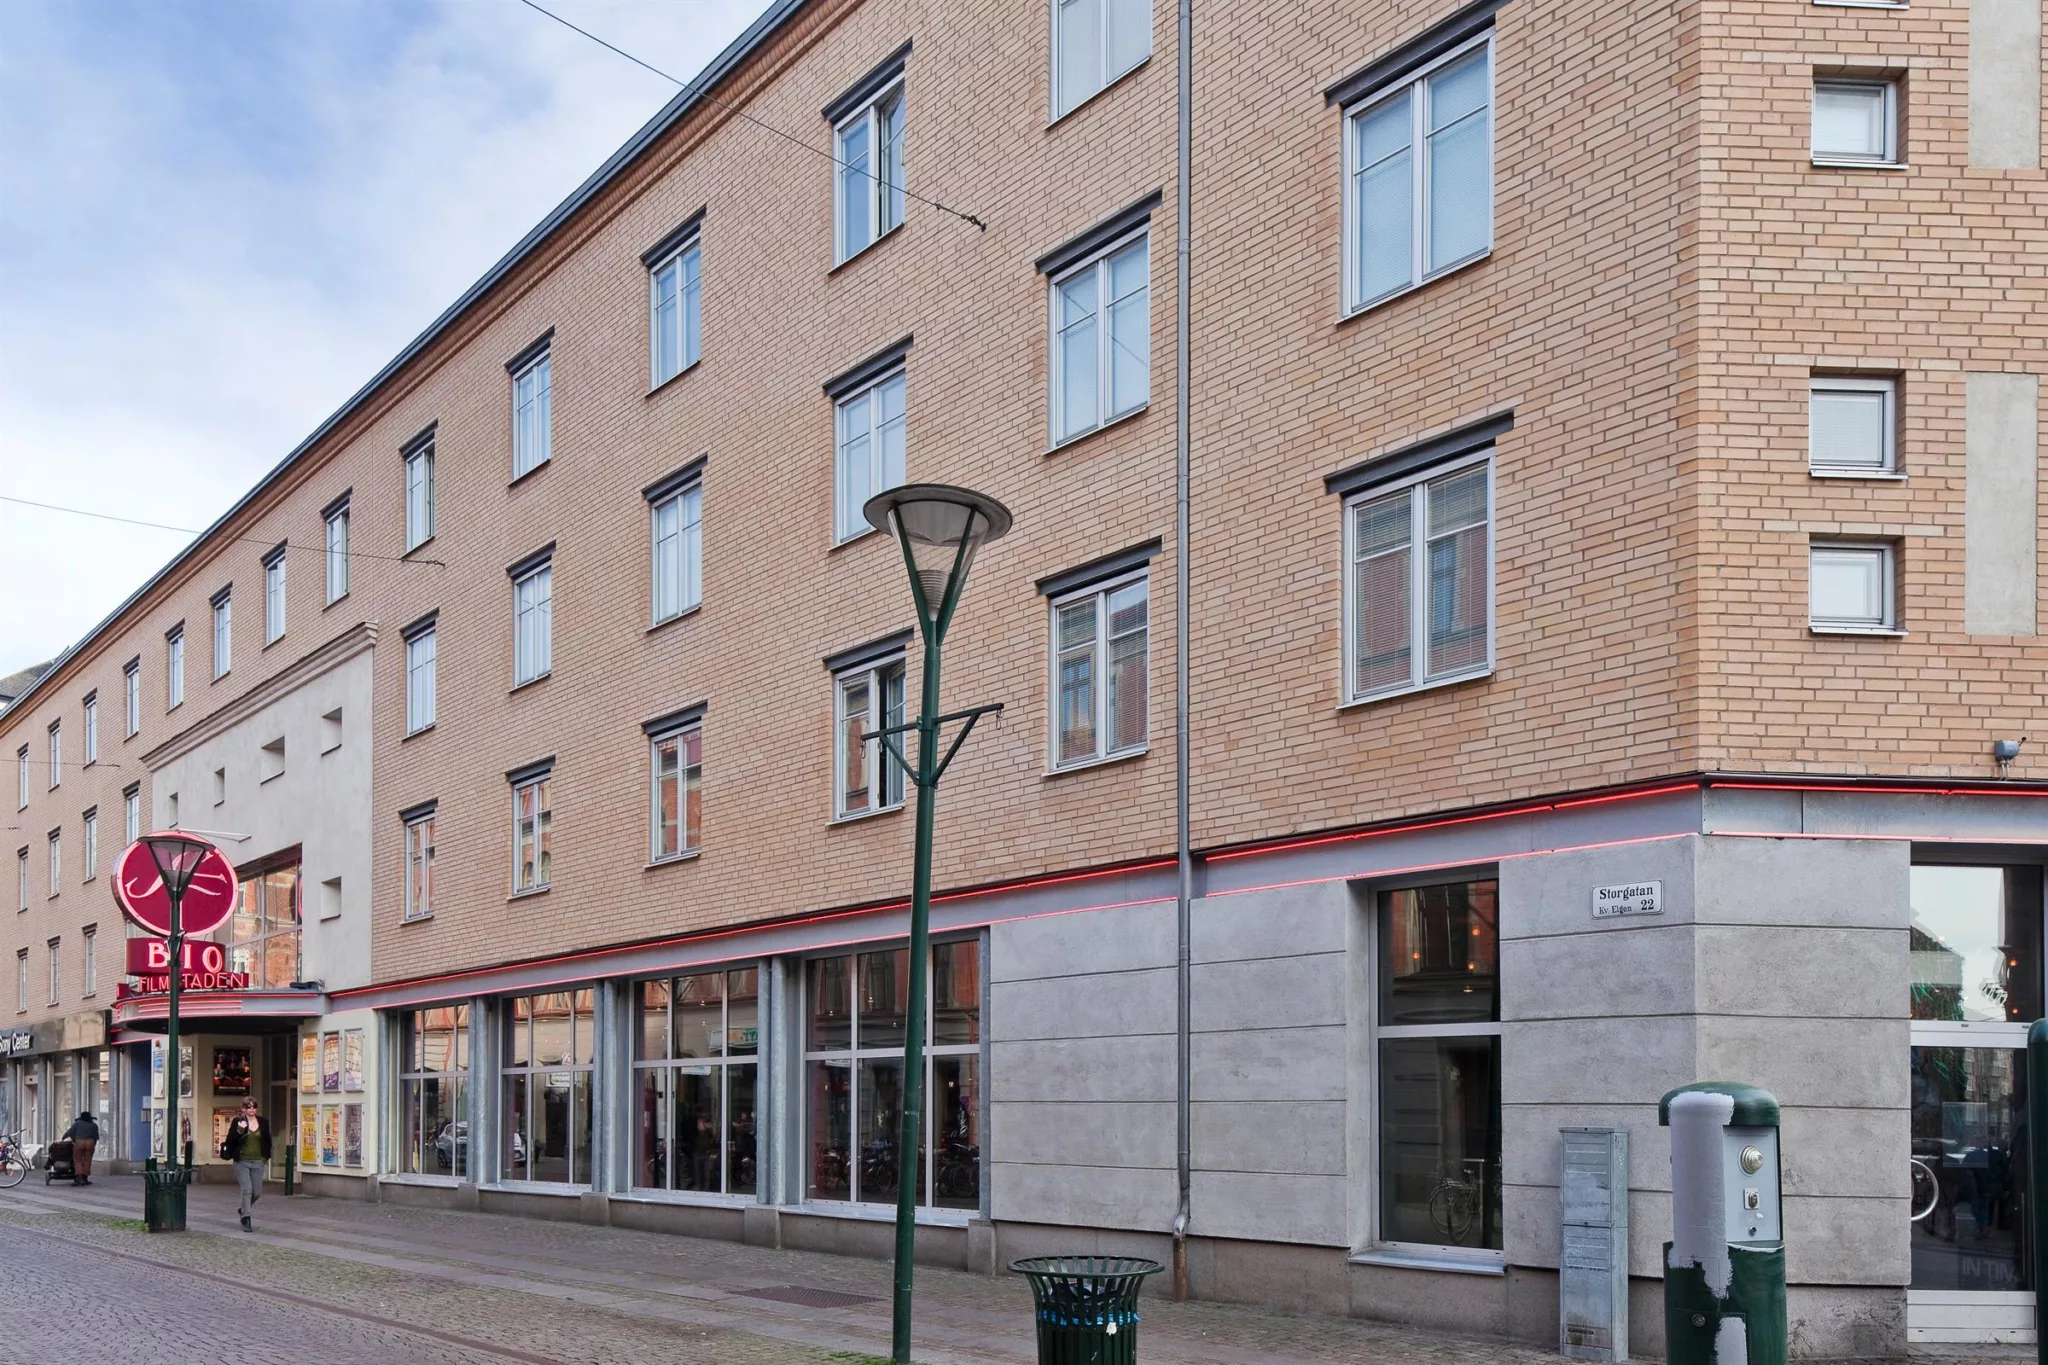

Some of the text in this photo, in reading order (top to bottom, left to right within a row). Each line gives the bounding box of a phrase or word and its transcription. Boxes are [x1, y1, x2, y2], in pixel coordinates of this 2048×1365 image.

[1599, 886, 1653, 900] Storgatan
[1611, 905, 1632, 914] Elgen
[1640, 898, 1654, 911] 22
[148, 942, 223, 973] BIO
[140, 972, 244, 992] FILMTADEN
[12, 1032, 31, 1052] Center
